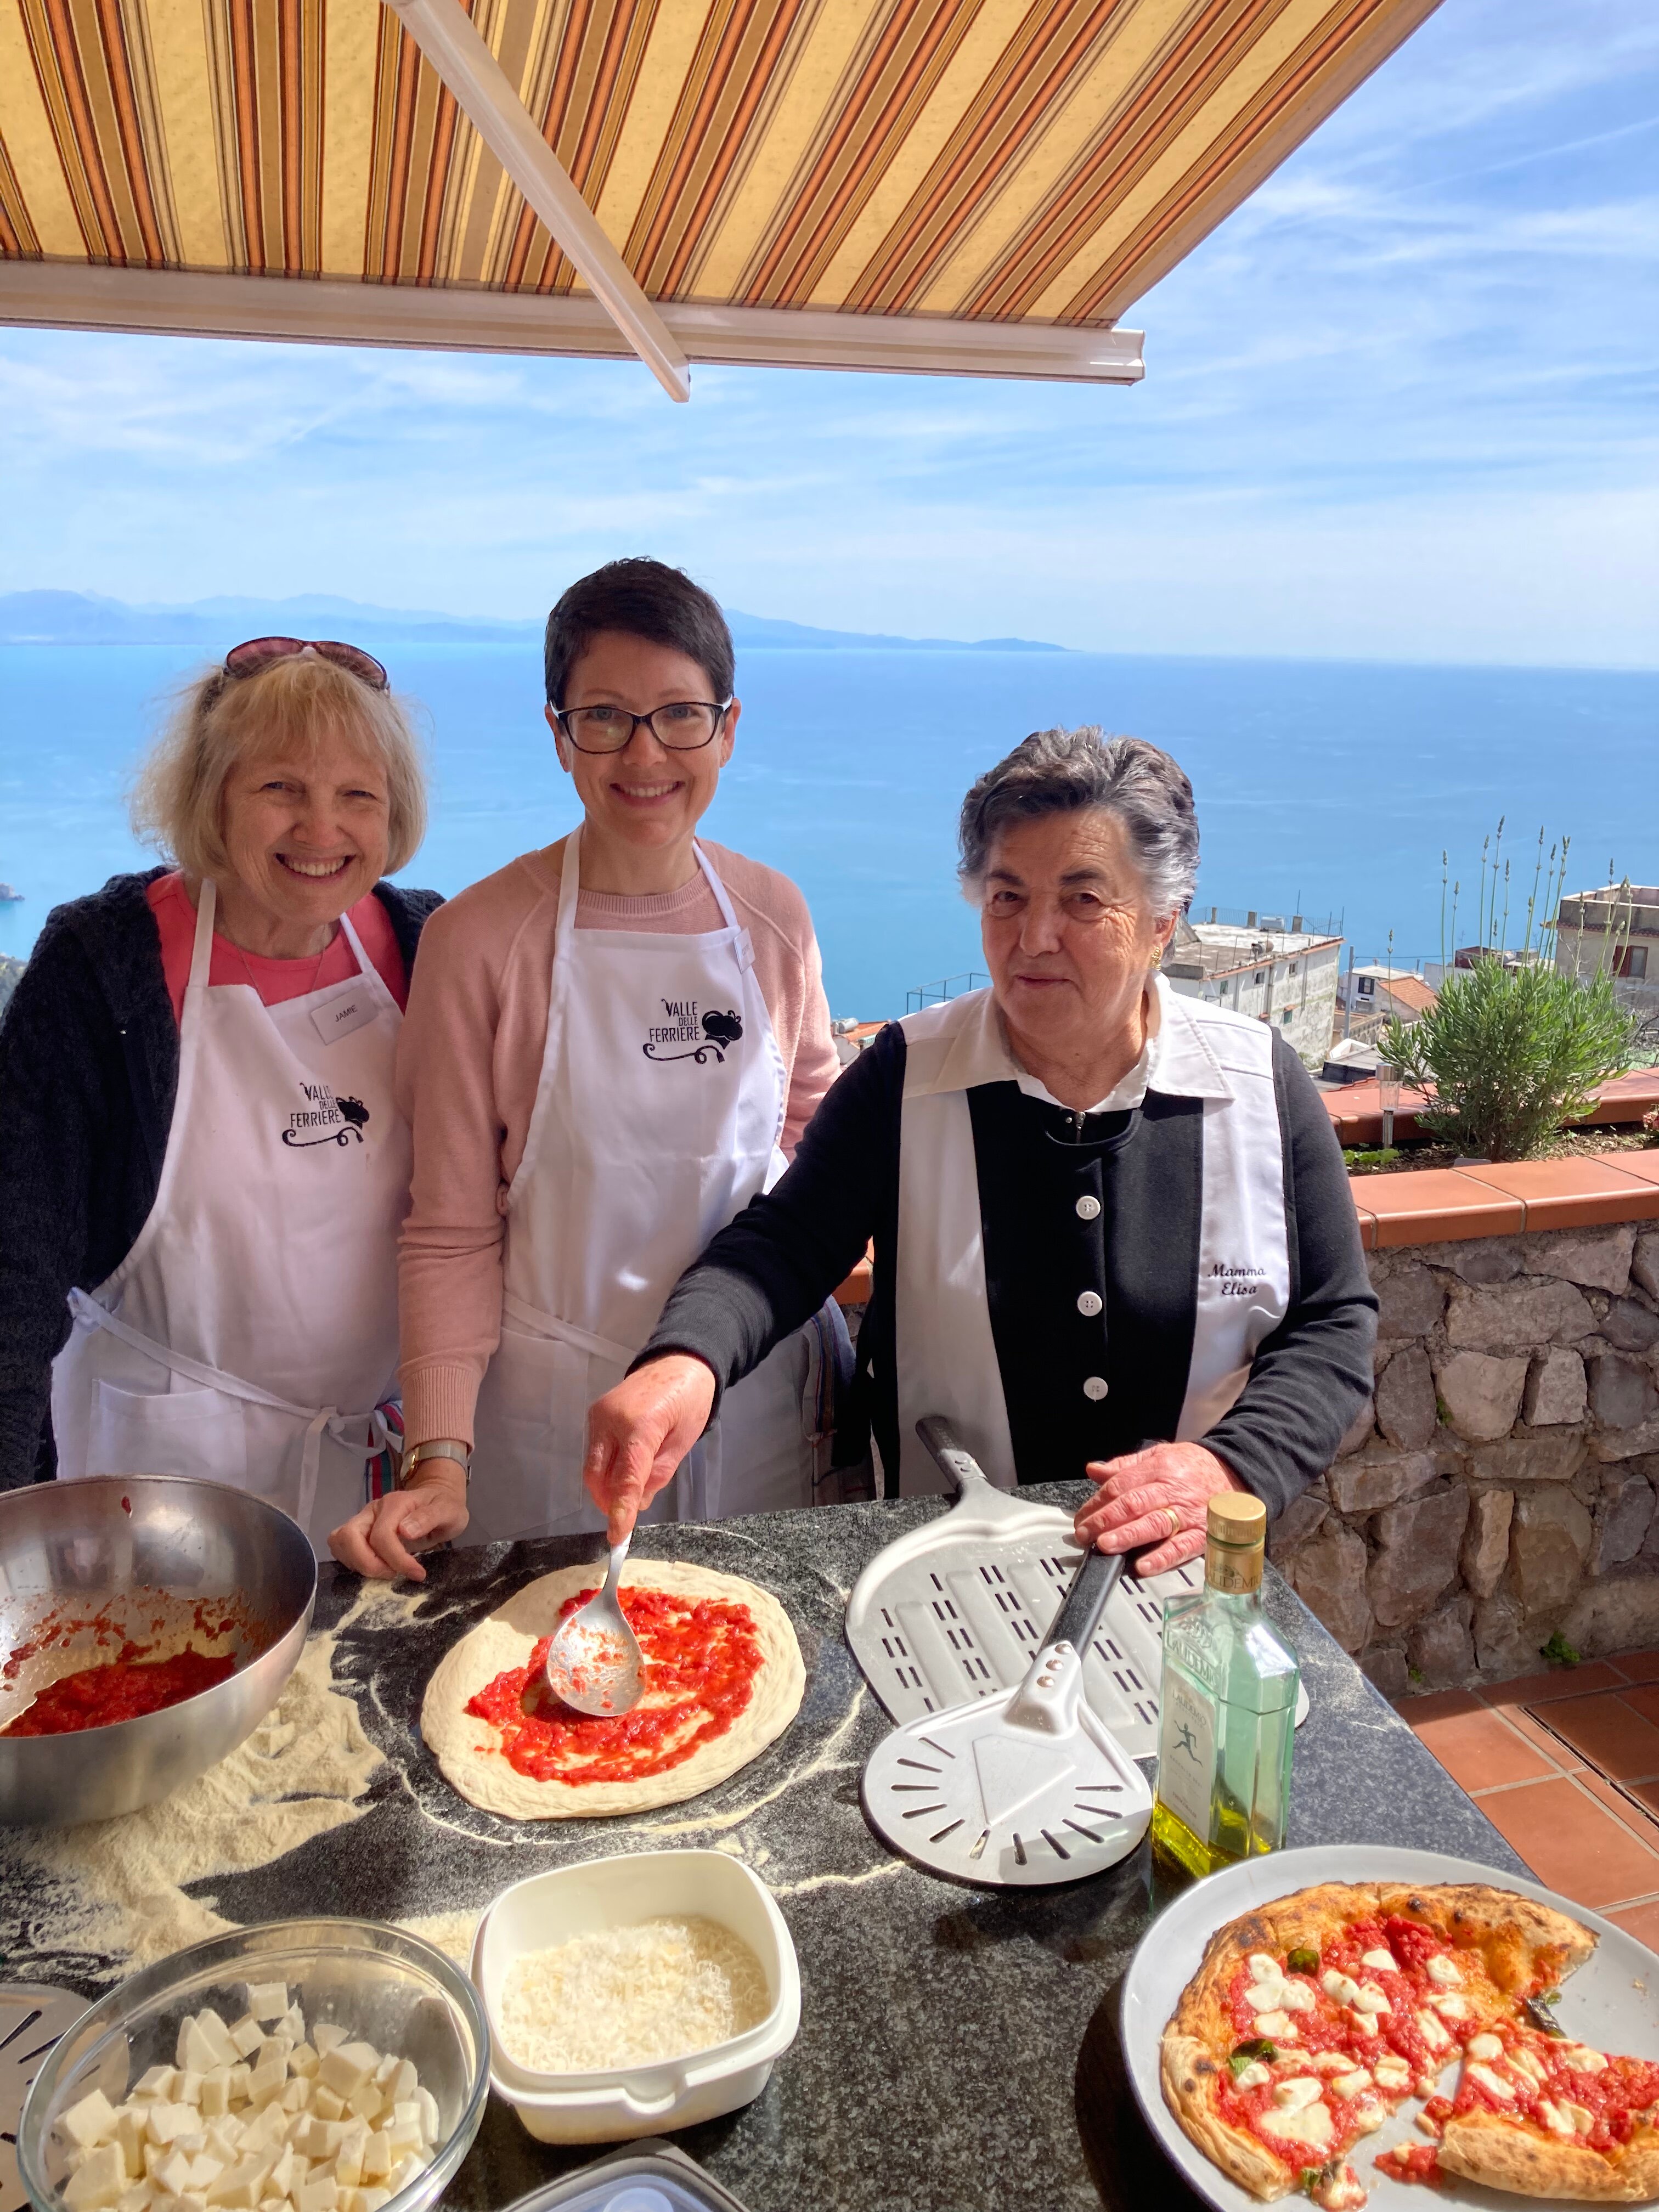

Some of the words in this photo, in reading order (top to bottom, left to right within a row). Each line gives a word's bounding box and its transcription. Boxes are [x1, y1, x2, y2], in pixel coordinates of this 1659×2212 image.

[334, 1005, 358, 1022] JAMIE
[661, 998, 697, 1017] VALLE
[679, 1017, 698, 1026] DELLE
[649, 1026, 701, 1042] FERRIERE
[290, 1109, 341, 1127] FERRIERE
[1207, 1264, 1266, 1277] Mamma
[1222, 1282, 1257, 1295] Elisa
